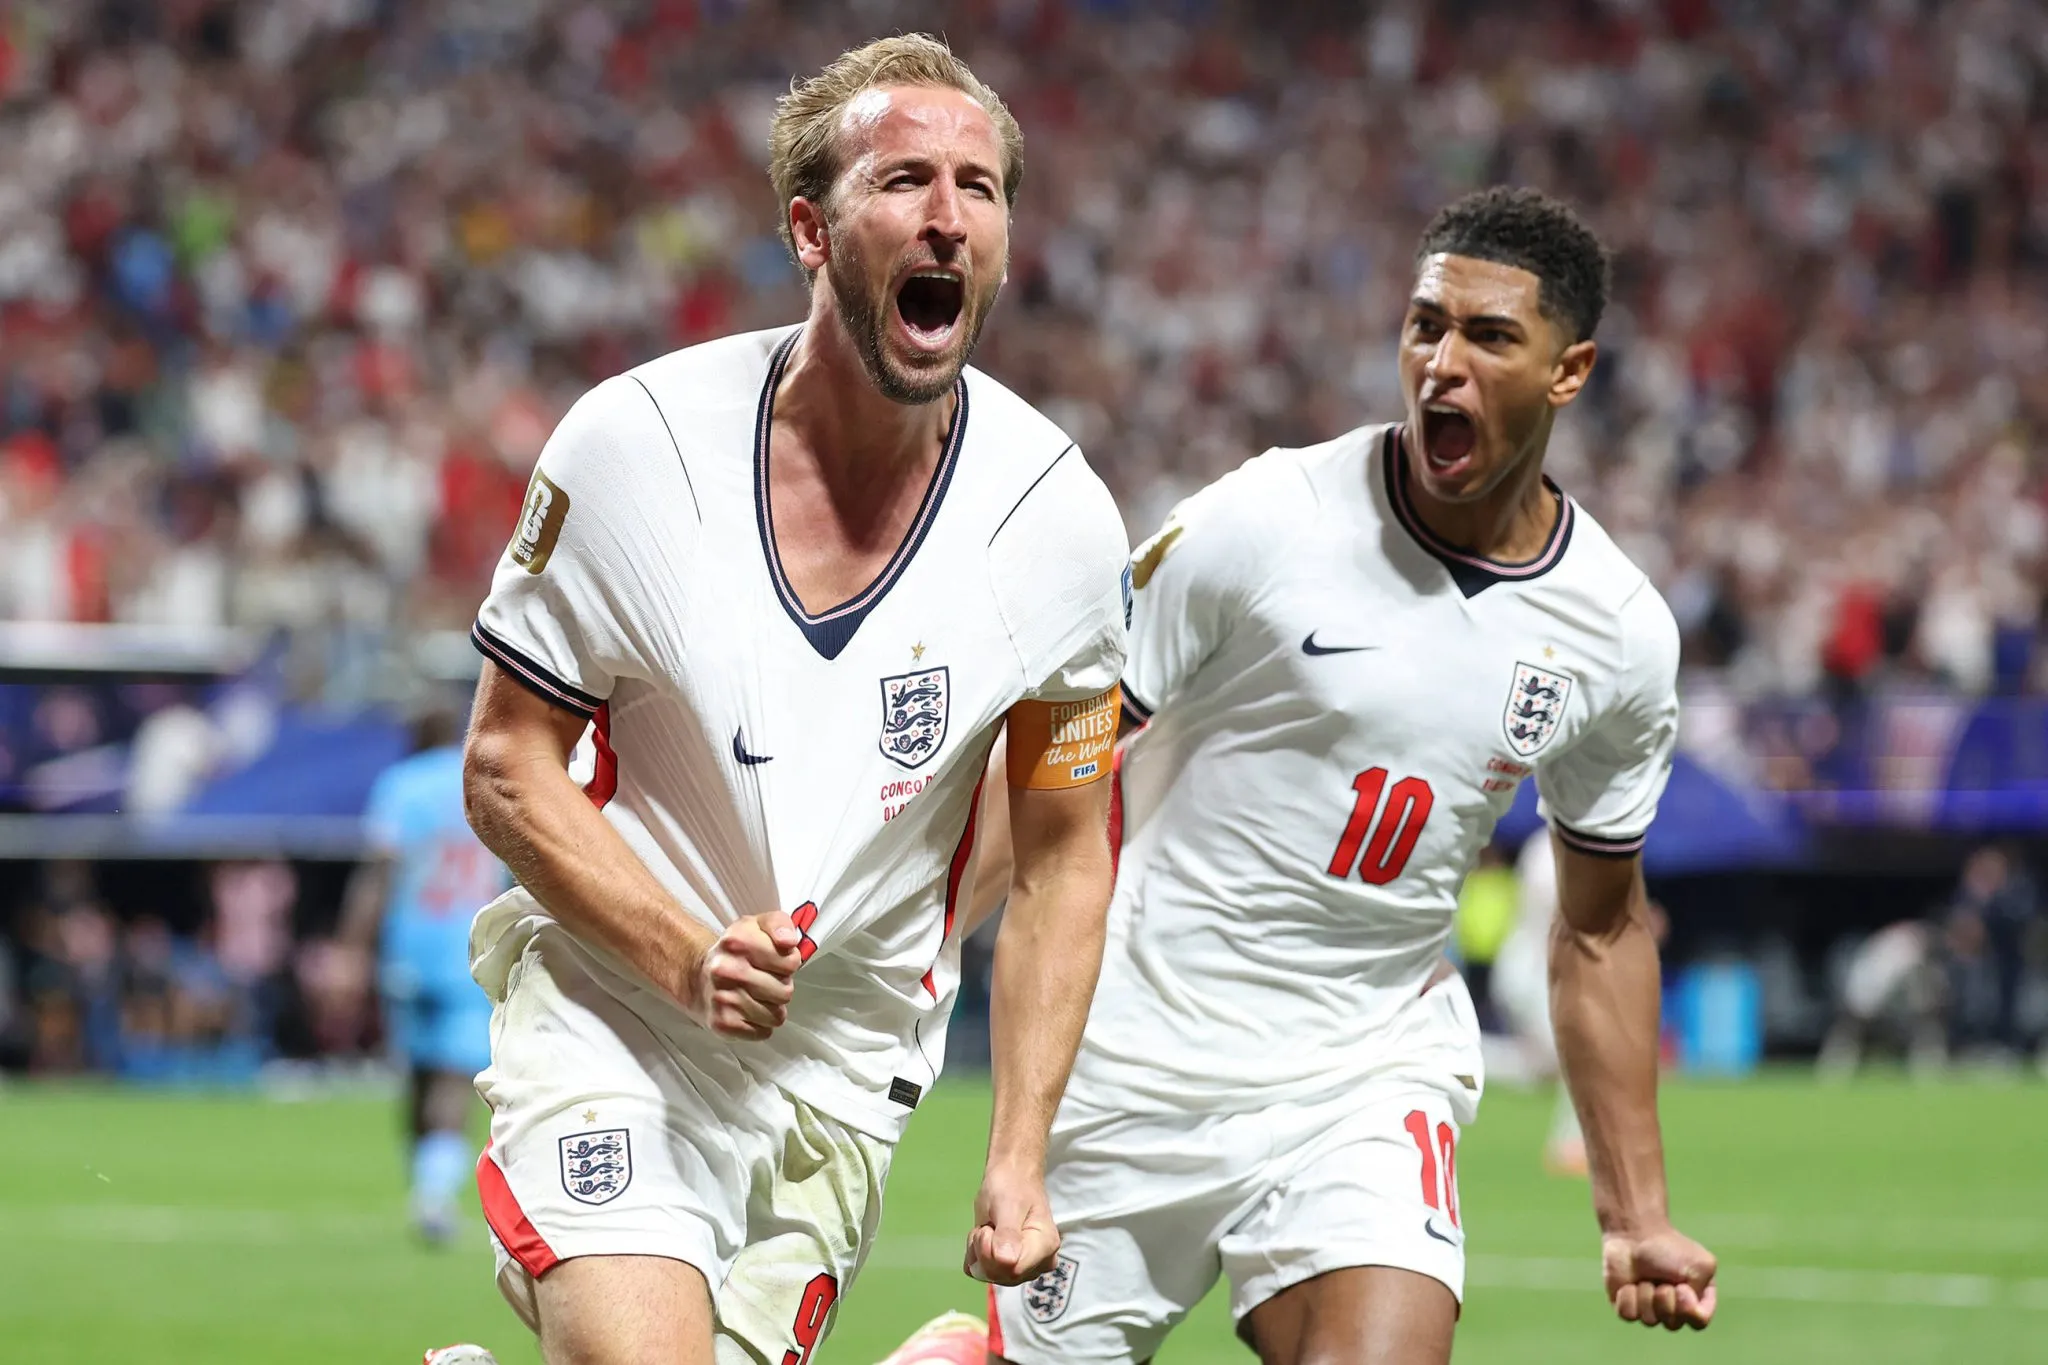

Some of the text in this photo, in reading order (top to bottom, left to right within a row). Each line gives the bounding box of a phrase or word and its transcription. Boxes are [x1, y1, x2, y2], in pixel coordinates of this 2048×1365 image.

[1051, 692, 1113, 721] FOOTBALL
[1051, 709, 1113, 744] UNITES
[1044, 732, 1113, 765] the World
[1074, 764, 1096, 777] FIFA
[880, 779, 922, 800] CONGO
[1327, 766, 1434, 885] 10
[1404, 1109, 1459, 1230] 10
[781, 1272, 838, 1365] 9
